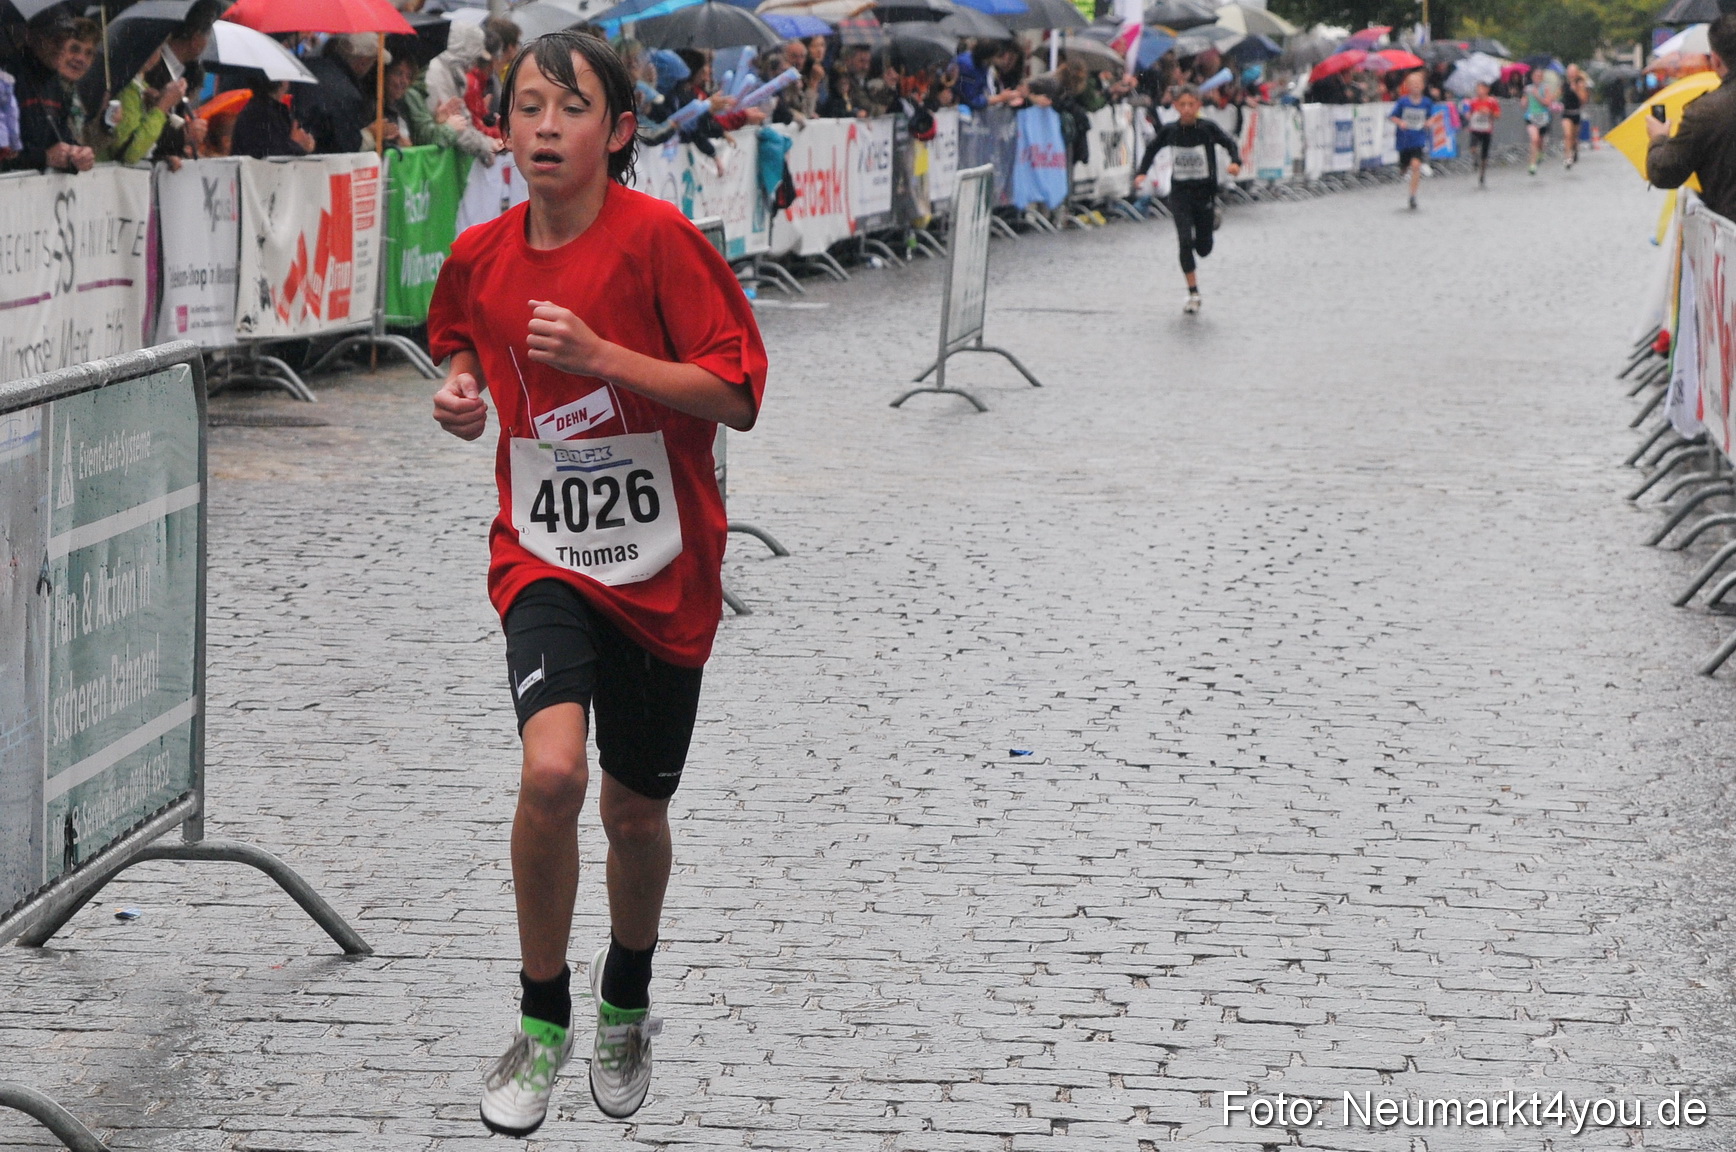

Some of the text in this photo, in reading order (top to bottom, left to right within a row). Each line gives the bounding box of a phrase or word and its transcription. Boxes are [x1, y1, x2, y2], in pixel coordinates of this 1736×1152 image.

[556, 407, 588, 432] DEHN
[78, 428, 151, 480] Event-Leit-Systeme
[554, 445, 613, 464] BOCK
[530, 469, 660, 534] 4026
[555, 543, 639, 567] Thomas
[54, 547, 151, 648] Fun & Action in
[53, 633, 159, 747] sicheren Bahnen!
[152, 750, 170, 793] 6352
